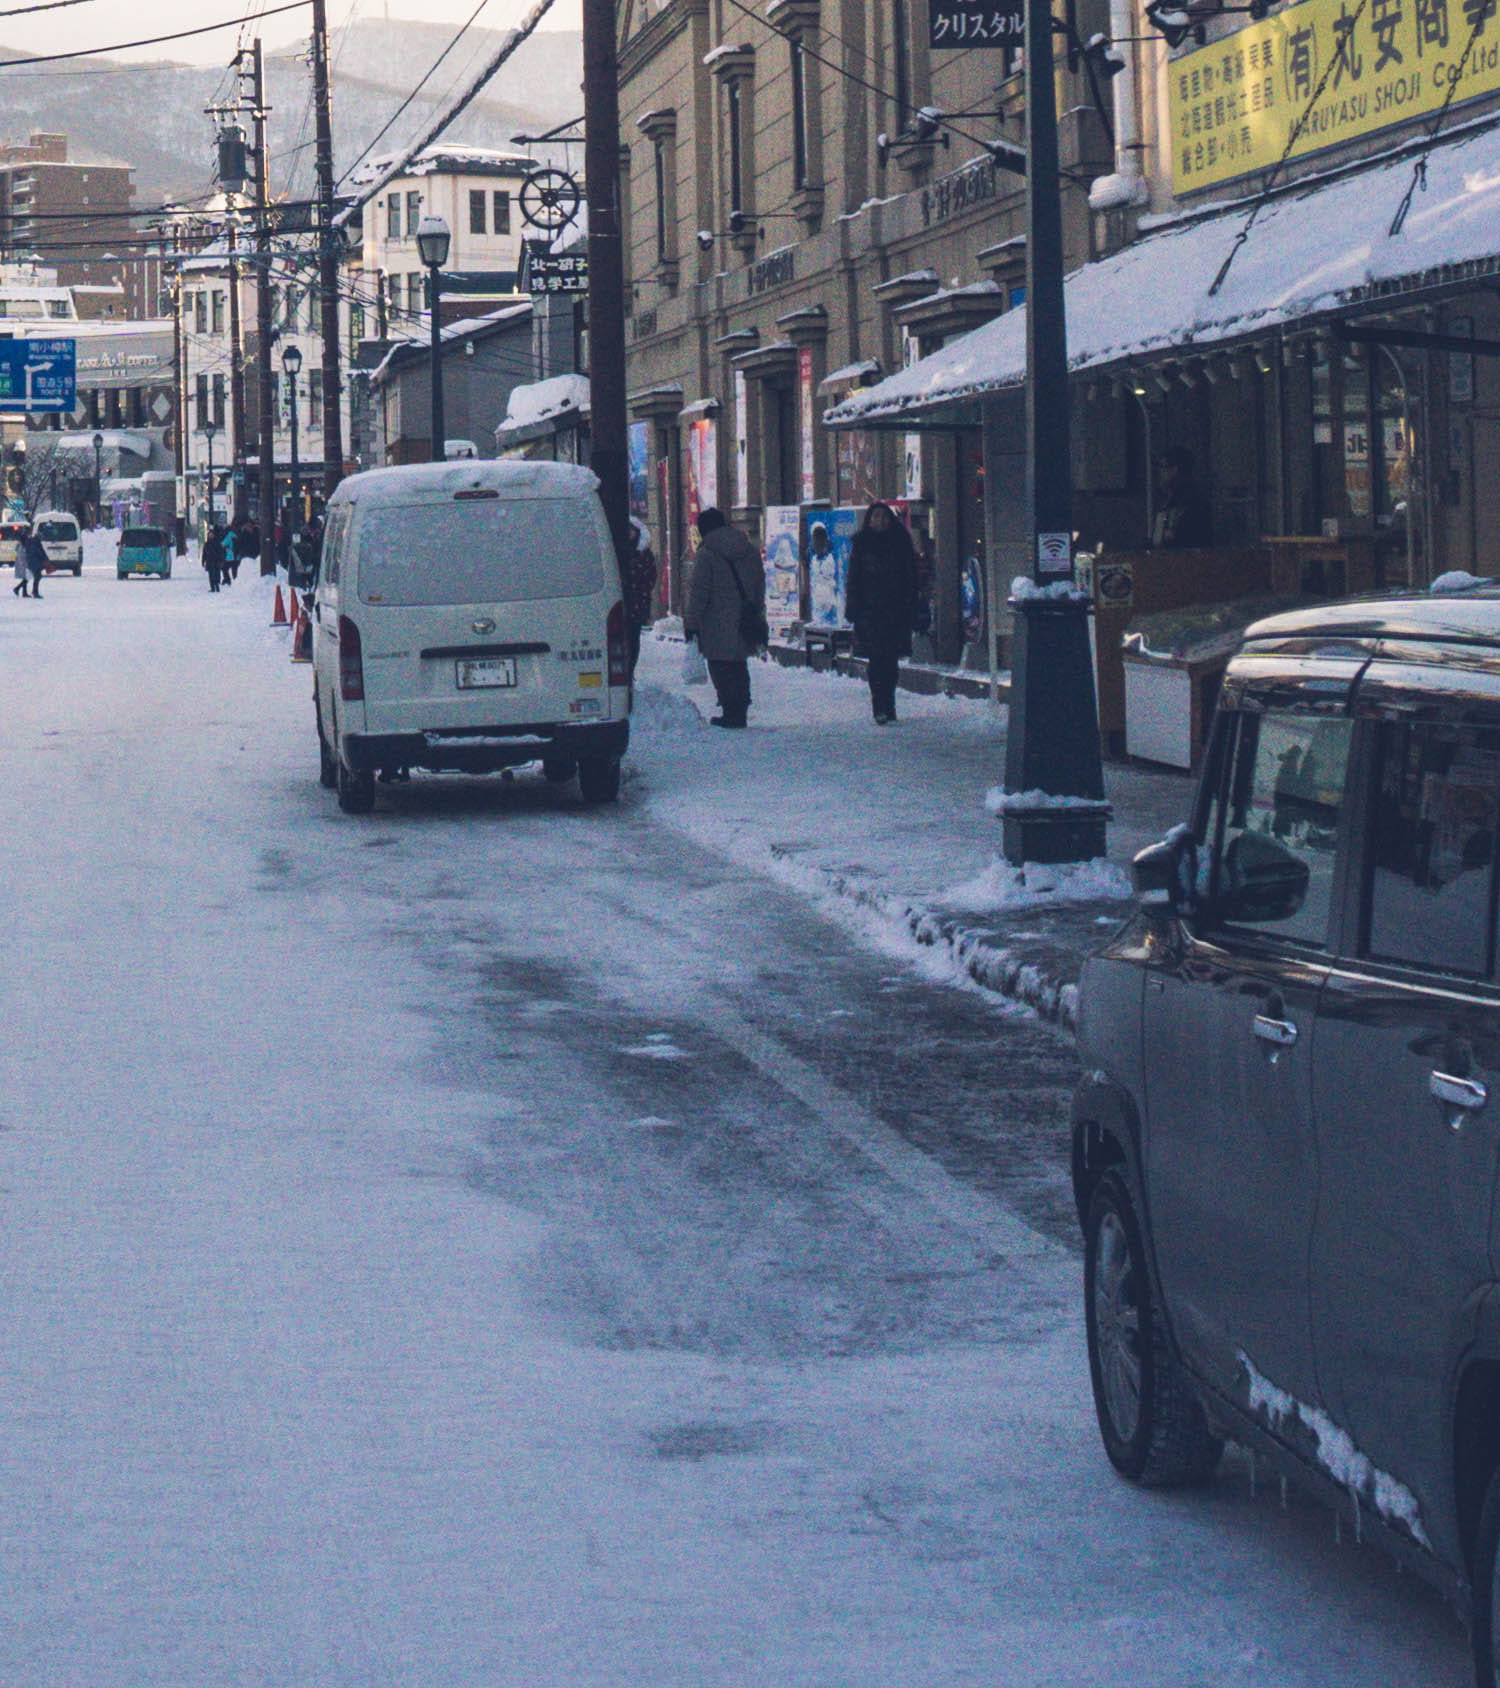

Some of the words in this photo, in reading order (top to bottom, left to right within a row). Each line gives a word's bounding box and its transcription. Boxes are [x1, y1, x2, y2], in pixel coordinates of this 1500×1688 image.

[933, 13, 1026, 40] クリスタル
[1290, 96, 1368, 139] MARUYASU
[1375, 72, 1421, 112] SHOJI
